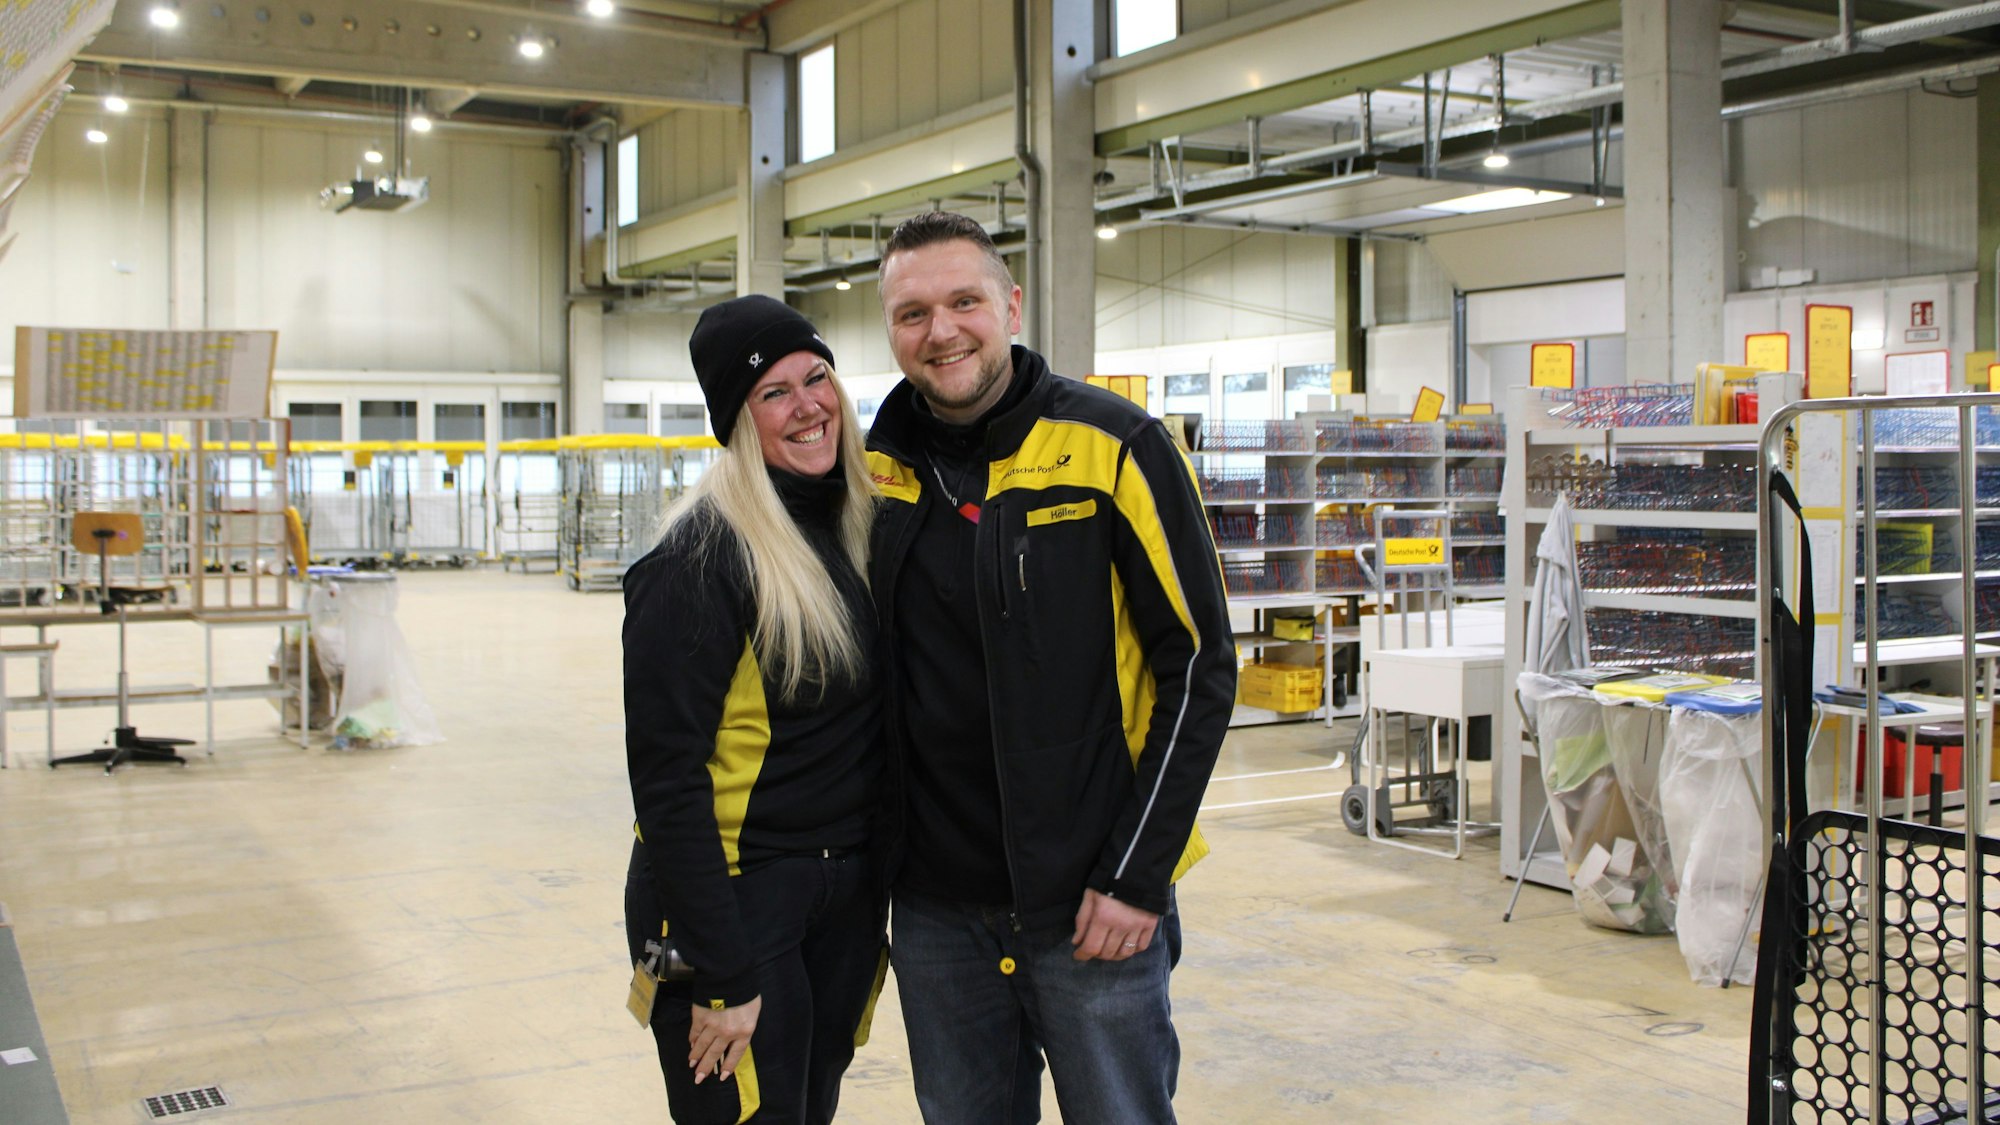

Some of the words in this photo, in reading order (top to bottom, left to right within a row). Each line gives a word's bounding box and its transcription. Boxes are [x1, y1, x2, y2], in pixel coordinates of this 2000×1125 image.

[1003, 467, 1035, 479] utsche
[1037, 465, 1054, 474] Post
[1051, 507, 1077, 520] Höller
